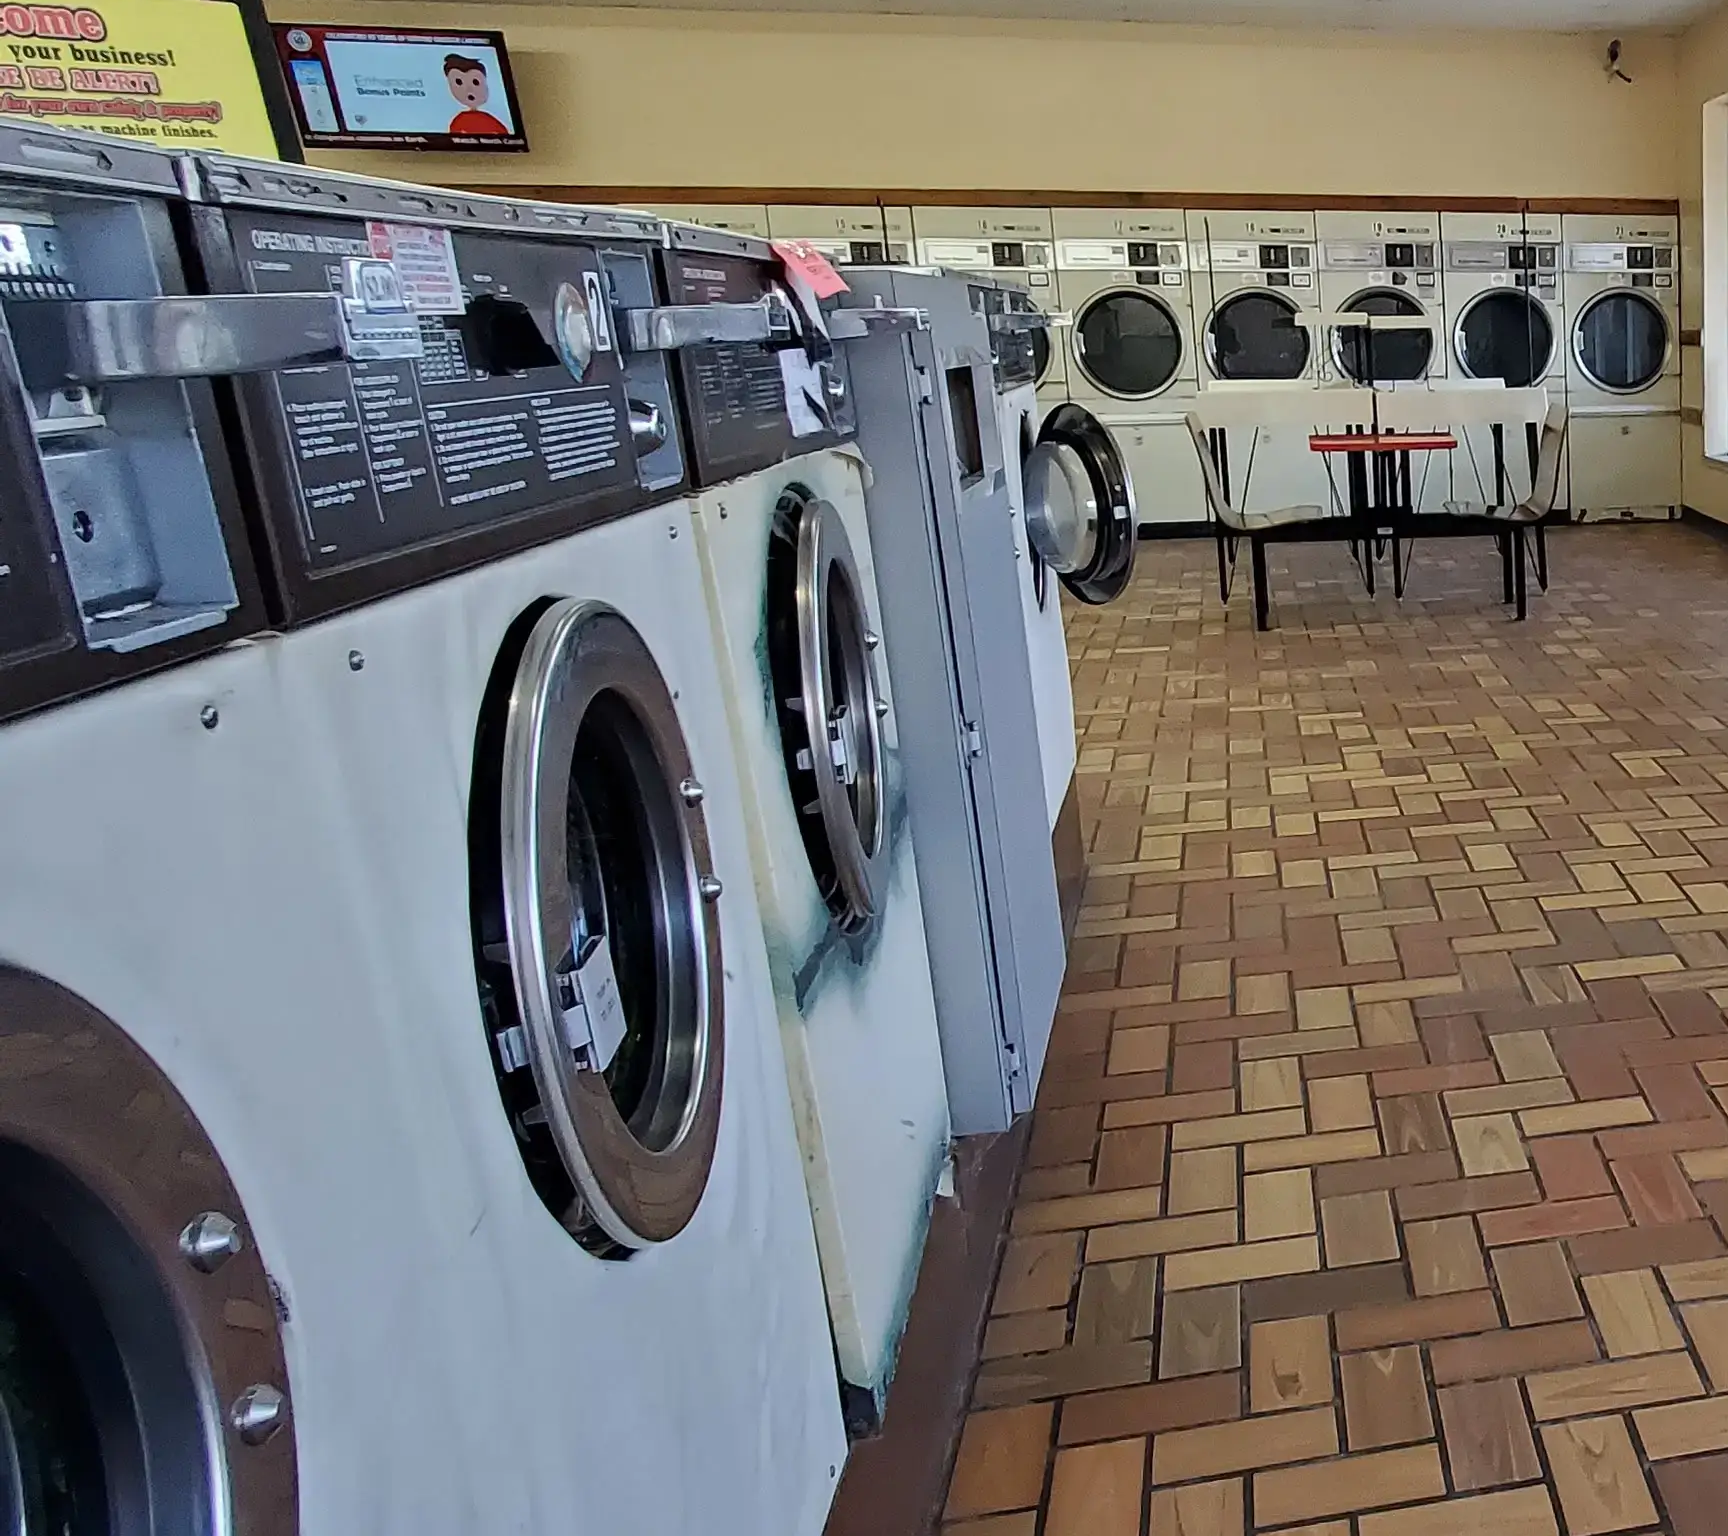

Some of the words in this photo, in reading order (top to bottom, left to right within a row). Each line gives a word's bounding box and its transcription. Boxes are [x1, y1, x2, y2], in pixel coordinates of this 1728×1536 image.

[0, 5, 105, 40] ome
[8, 44, 62, 63] your
[70, 45, 176, 66] business!
[27, 67, 65, 89] BE
[71, 70, 159, 94] ALERT!
[393, 88, 426, 97] Points
[101, 125, 157, 136] machine
[161, 125, 218, 139] finishes.
[252, 230, 315, 253] OPERATING
